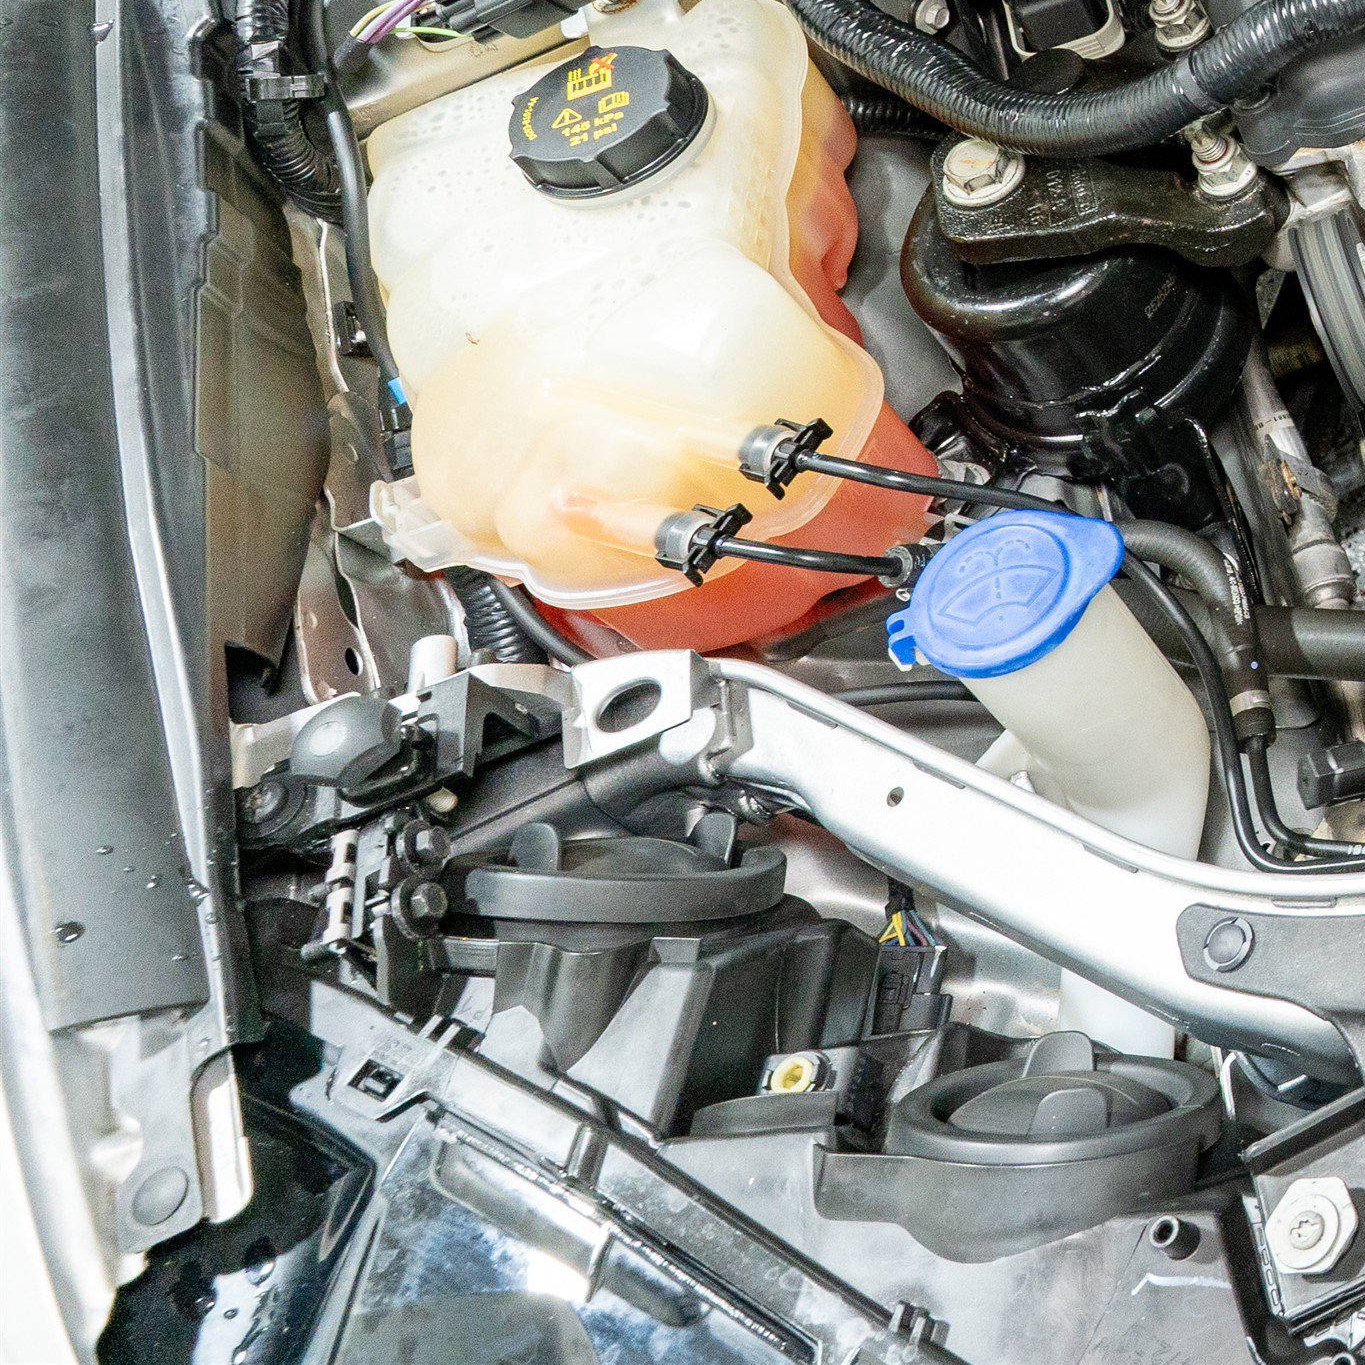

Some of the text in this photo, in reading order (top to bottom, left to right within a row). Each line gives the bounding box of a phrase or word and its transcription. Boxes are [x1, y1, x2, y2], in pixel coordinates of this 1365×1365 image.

[561, 111, 624, 137] 145 kPa
[569, 122, 618, 147] 21 psi
